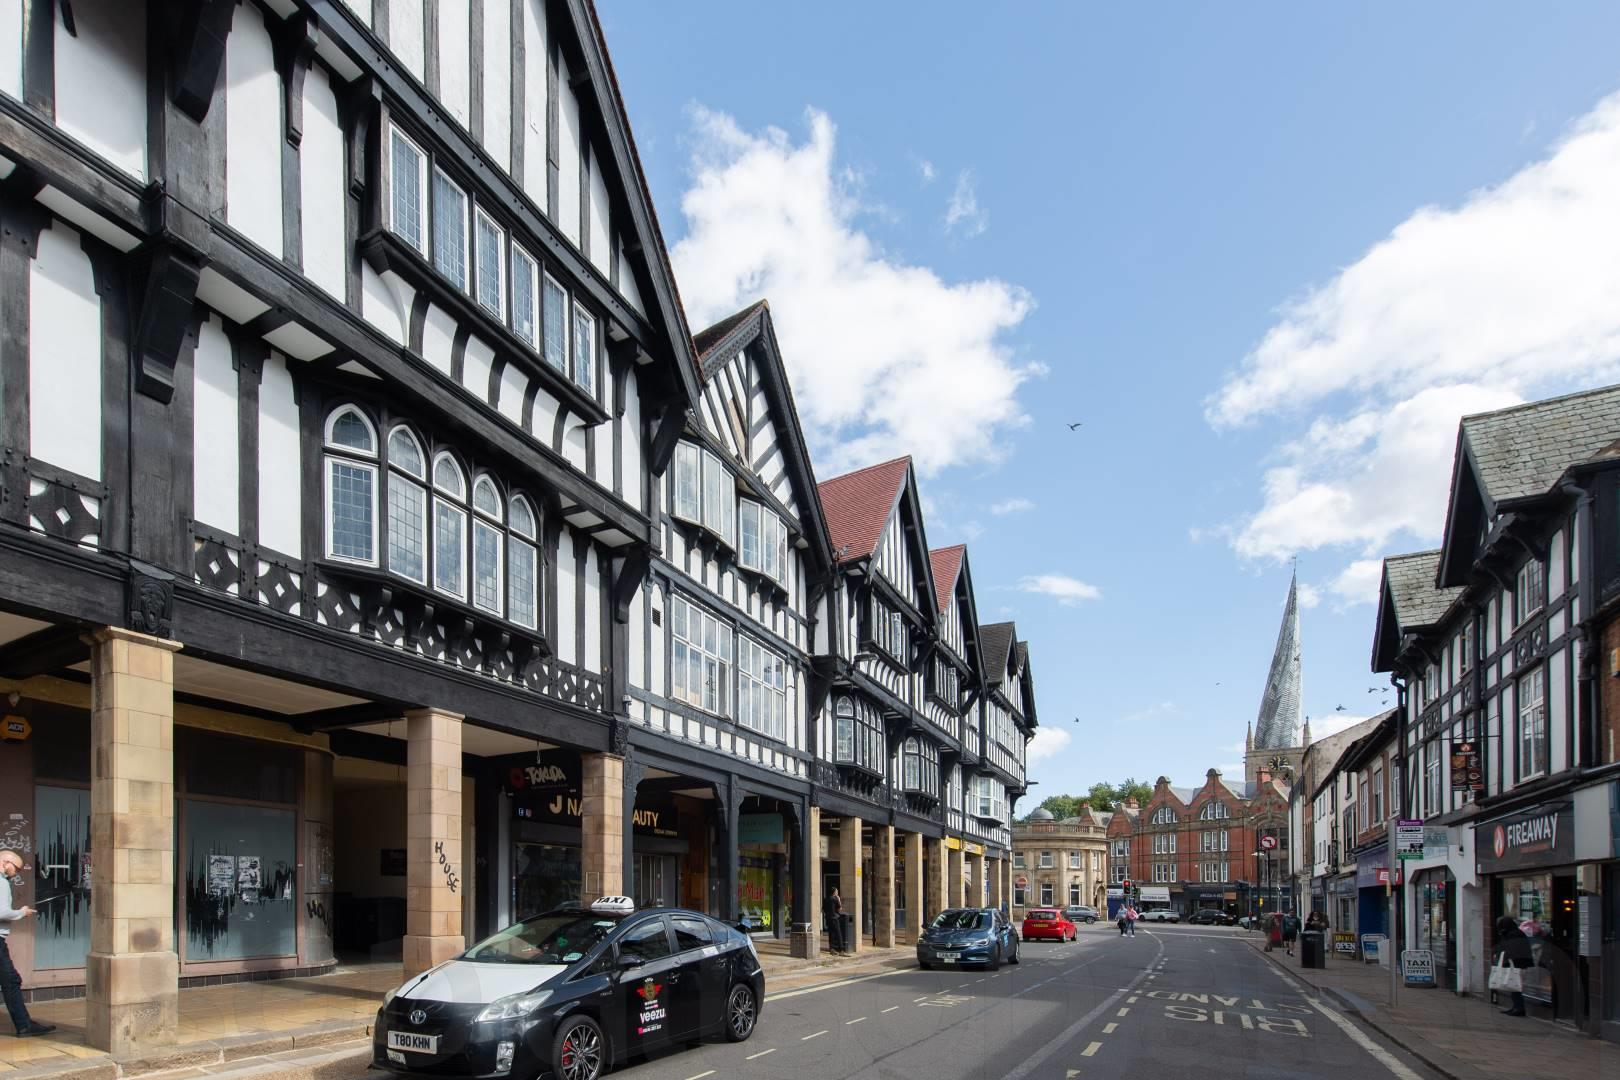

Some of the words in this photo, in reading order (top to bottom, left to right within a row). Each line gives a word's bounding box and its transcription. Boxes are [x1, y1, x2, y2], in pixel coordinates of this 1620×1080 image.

[550, 795, 562, 814] J
[632, 809, 659, 828] AUTY
[1507, 812, 1558, 849] FIREAWAY
[435, 841, 460, 893] HOUSE
[597, 896, 628, 904] TAXI
[1335, 942, 1356, 950] OPEN
[412, 1036, 430, 1049] KHN
